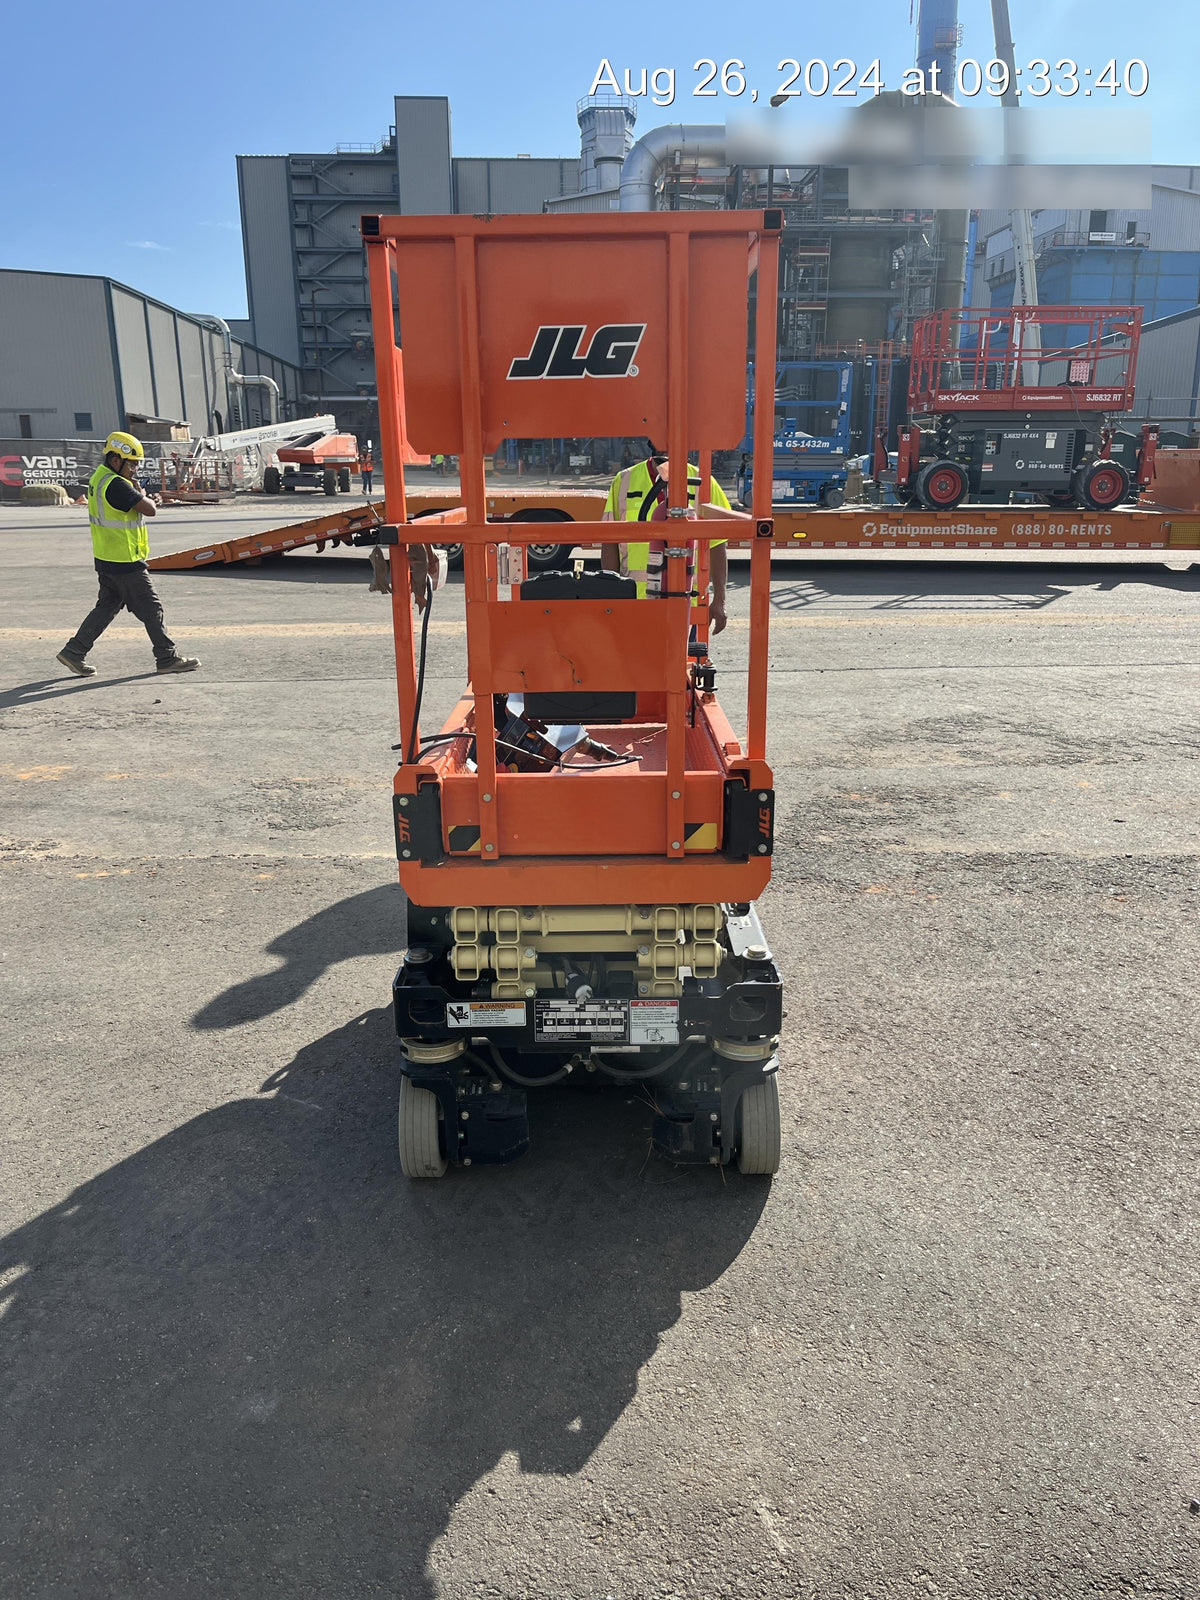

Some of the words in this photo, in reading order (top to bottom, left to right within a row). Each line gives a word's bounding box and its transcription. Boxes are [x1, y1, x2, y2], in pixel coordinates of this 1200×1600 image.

[938, 392, 980, 401] SKYJACK
[1086, 393, 1112, 402] SJ6832
[1112, 393, 1122, 401] RT
[785, 440, 830, 448] GS-1432m
[23, 470, 78, 478] GENERAL
[24, 478, 80, 486] CONTRACTORS
[879, 523, 998, 537] EquipmentShare
[1011, 523, 1046, 535] (888)
[1048, 523, 1112, 535] 80-RENTS
[759, 808, 771, 838] JLG
[398, 813, 411, 843] JLG
